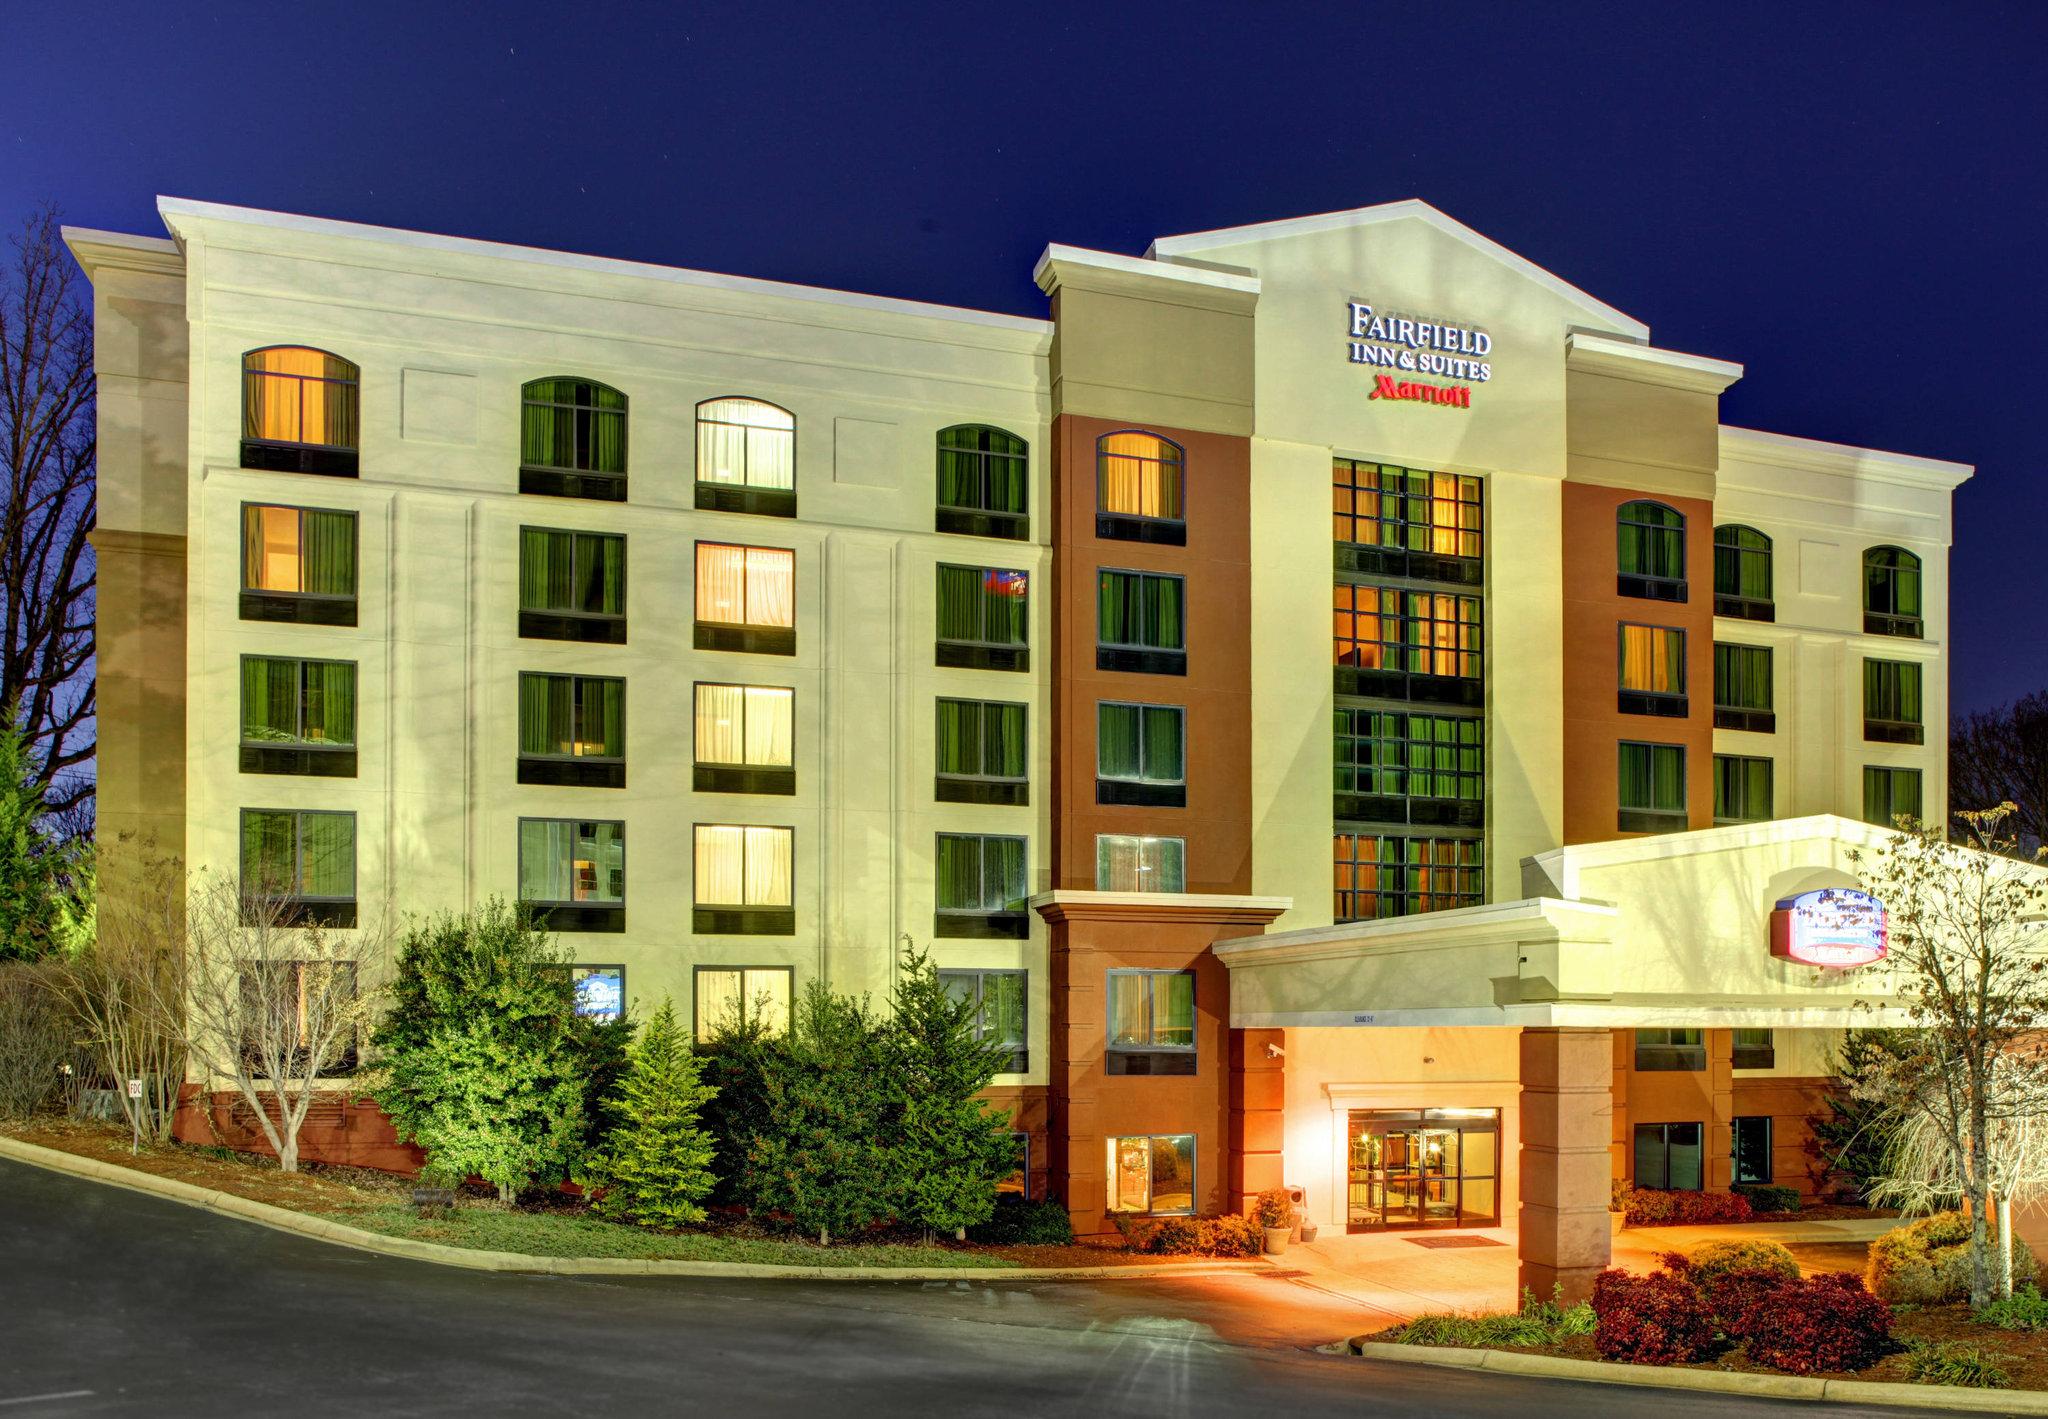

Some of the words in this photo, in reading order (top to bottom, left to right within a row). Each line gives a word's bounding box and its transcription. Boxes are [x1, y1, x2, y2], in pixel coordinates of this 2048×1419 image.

[1349, 302, 1492, 356] FAIRFIELD
[1349, 342, 1396, 367] INN
[1399, 350, 1416, 371] &
[1418, 353, 1491, 382] SUITES
[1369, 374, 1471, 408] Marriott
[130, 1083, 141, 1094] FDC
